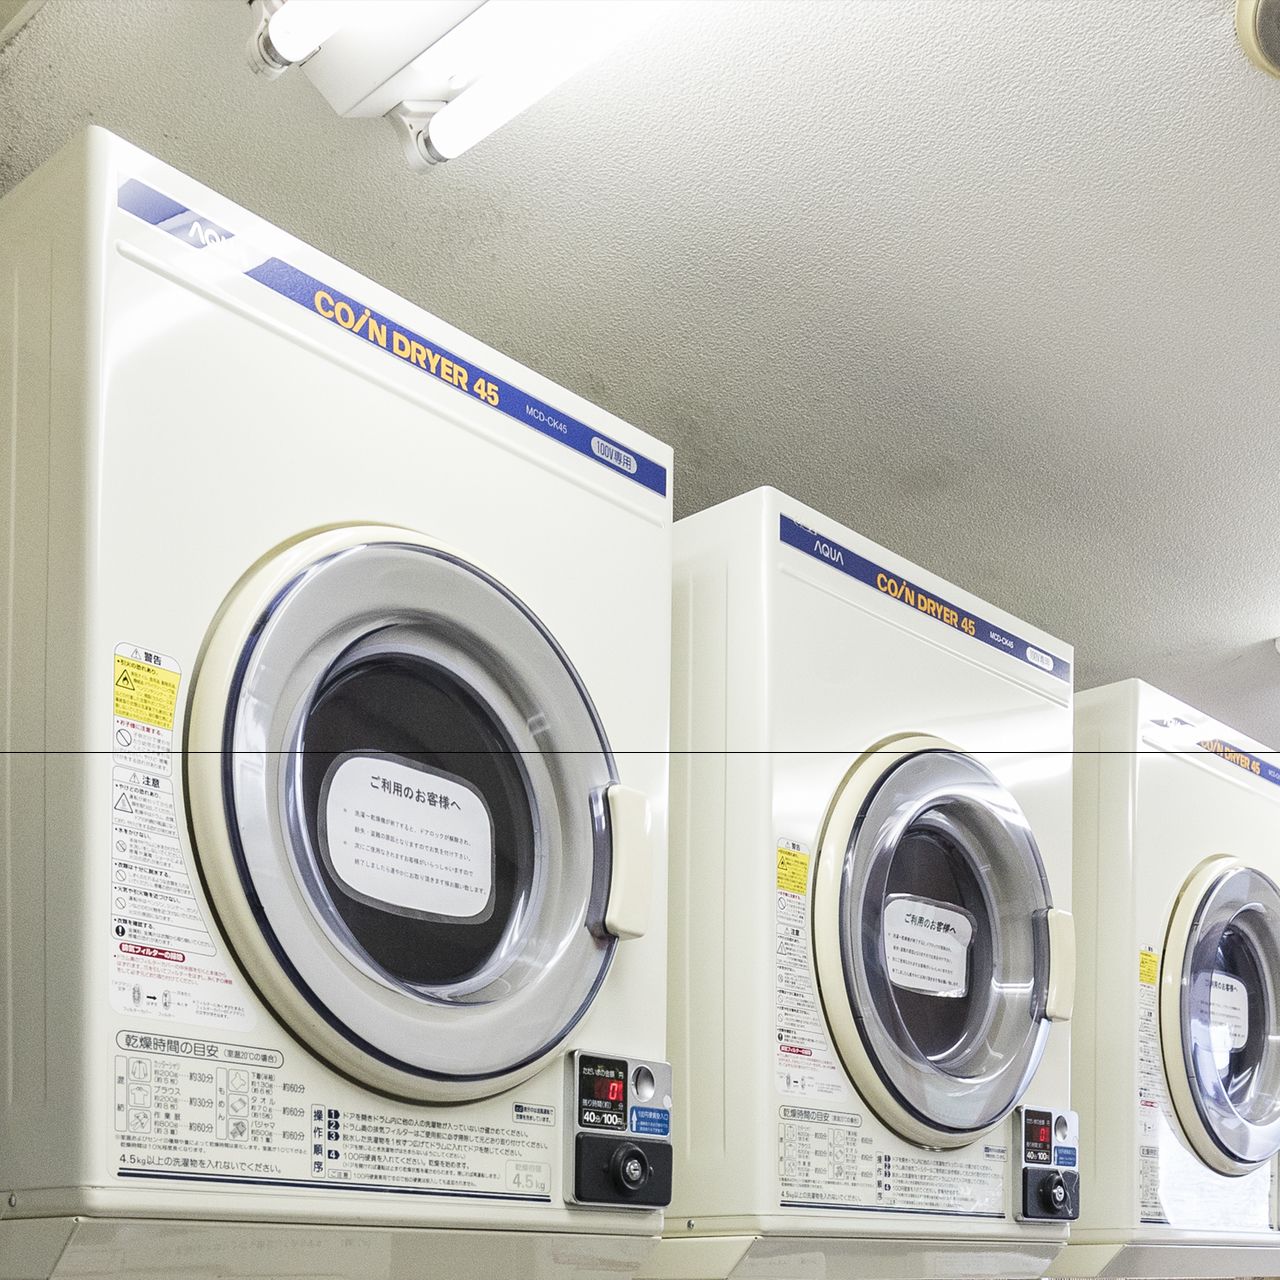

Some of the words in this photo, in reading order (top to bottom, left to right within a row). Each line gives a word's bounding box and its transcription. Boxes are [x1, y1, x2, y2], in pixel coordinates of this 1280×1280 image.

[393, 331, 469, 392] DRYER
[473, 377, 500, 406] 45
[525, 405, 568, 434] MCD-CK45
[596, 440, 632, 471] 100V専用
[814, 540, 844, 566] AQUA
[918, 592, 959, 628] DRYER
[960, 618, 976, 637] 45
[144, 651, 161, 666] 警告
[1224, 746, 1250, 770] DRYER
[1251, 760, 1261, 776] 45
[142, 775, 160, 789] 注意
[370, 775, 462, 811] ご利用のお客様へ
[904, 913, 957, 934] ご利用のお客様へ
[124, 1034, 219, 1059] 乾燥時間の目安
[189, 1072, 214, 1084] 約30分
[154, 1085, 181, 1096] ブラウス
[282, 1082, 306, 1094] 約60分
[609, 1082, 618, 1100] 0
[189, 1097, 214, 1108] 約30分
[251, 1095, 276, 1106] タオル
[282, 1106, 305, 1117] 約60分
[783, 1108, 830, 1122] 乾燥時間の目安
[189, 1122, 214, 1133] 約60分
[251, 1120, 275, 1129] パジャマ
[282, 1130, 305, 1141] 約60分
[313, 1109, 324, 1174] 操作順序
[512, 1173, 546, 1192] 4.5kg
